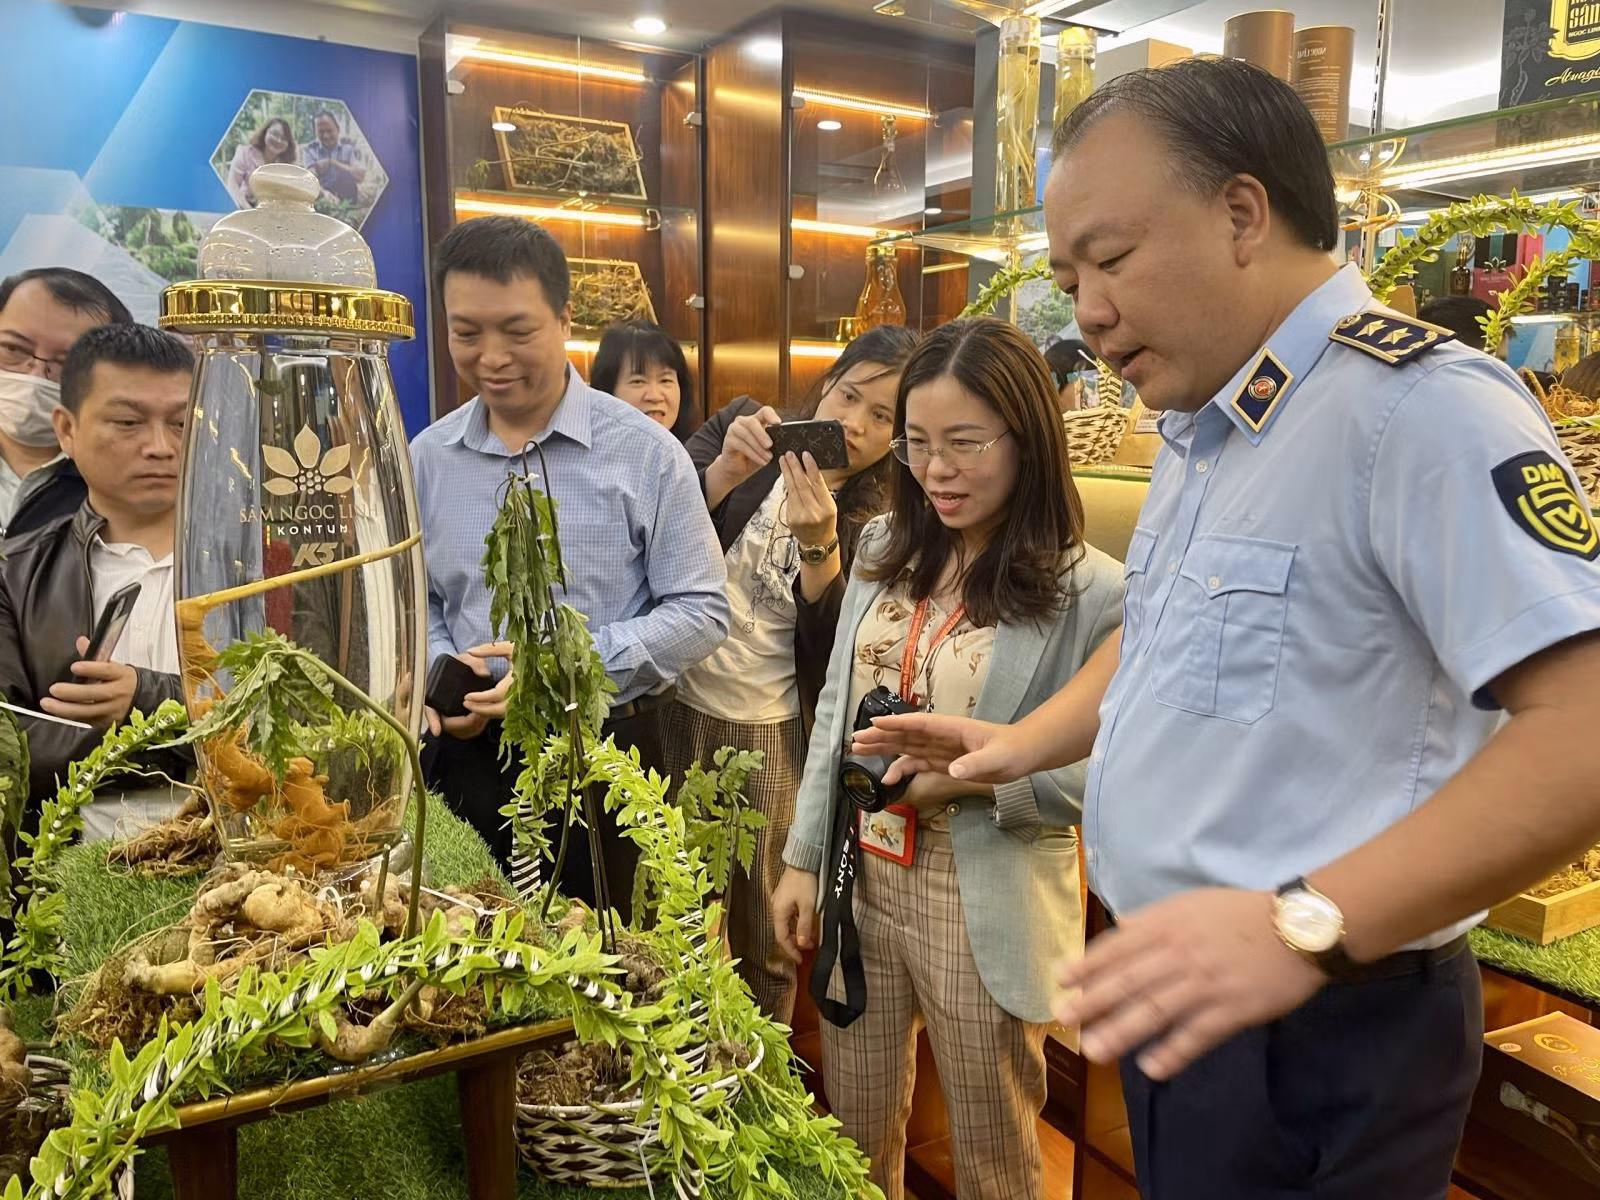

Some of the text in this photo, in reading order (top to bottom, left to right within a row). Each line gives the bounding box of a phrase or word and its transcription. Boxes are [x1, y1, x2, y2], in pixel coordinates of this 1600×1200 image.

[239, 504, 274, 523] SÂM
[280, 504, 334, 522] NGỌC
[277, 524, 348, 536] KONTUM
